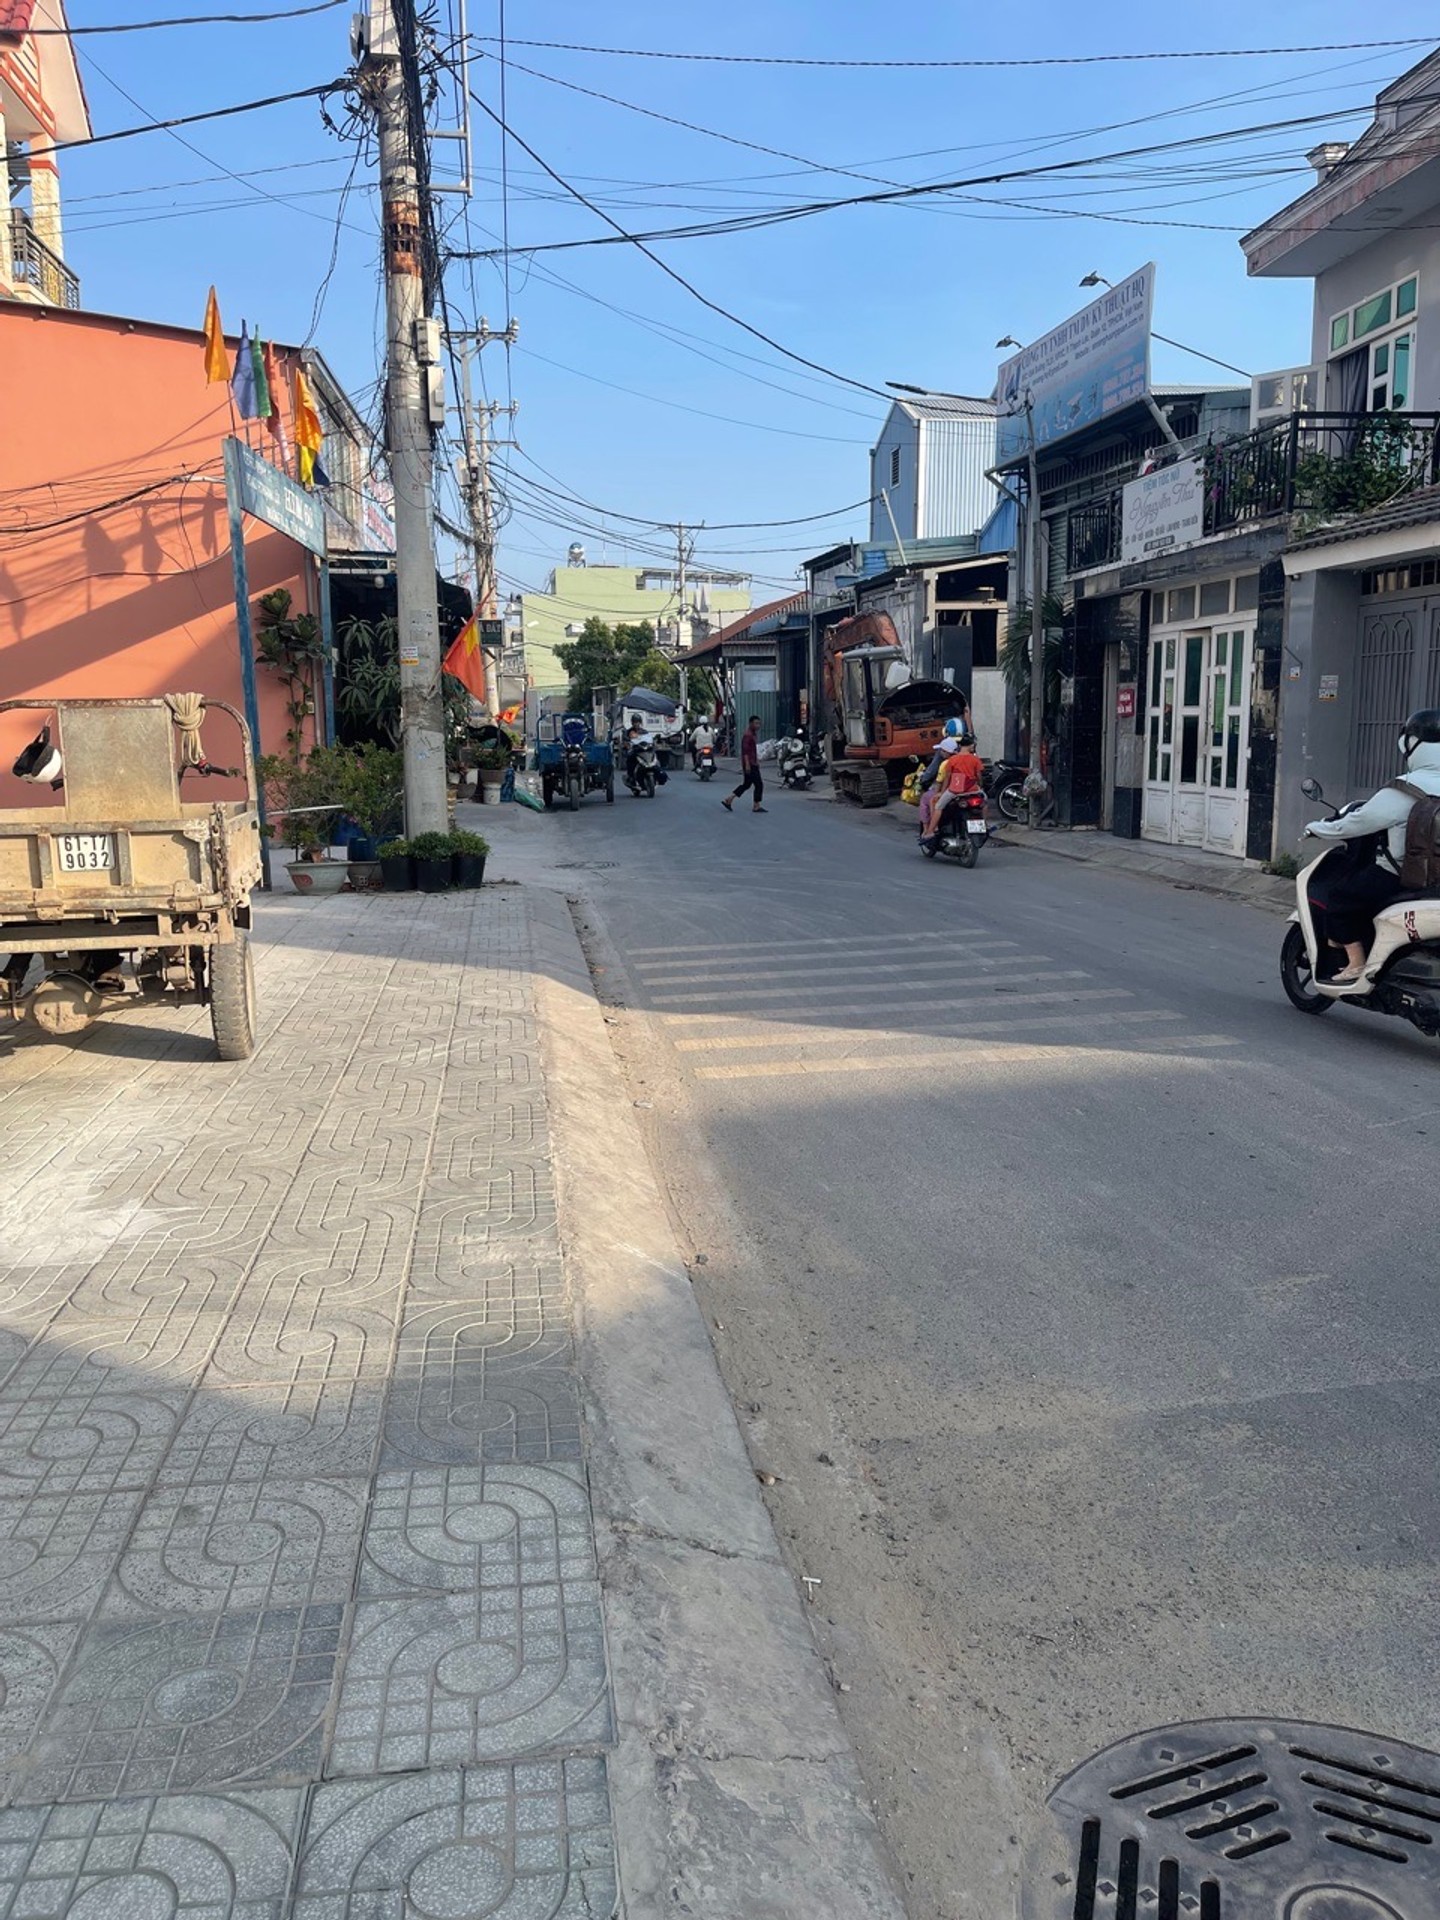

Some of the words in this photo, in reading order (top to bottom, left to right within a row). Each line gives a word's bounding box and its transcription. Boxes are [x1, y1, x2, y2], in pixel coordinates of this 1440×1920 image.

[1040, 341, 1049, 358] TY
[1049, 327, 1068, 352] TNHH
[65, 834, 106, 851] 61-T7
[66, 851, 110, 869] 9032
